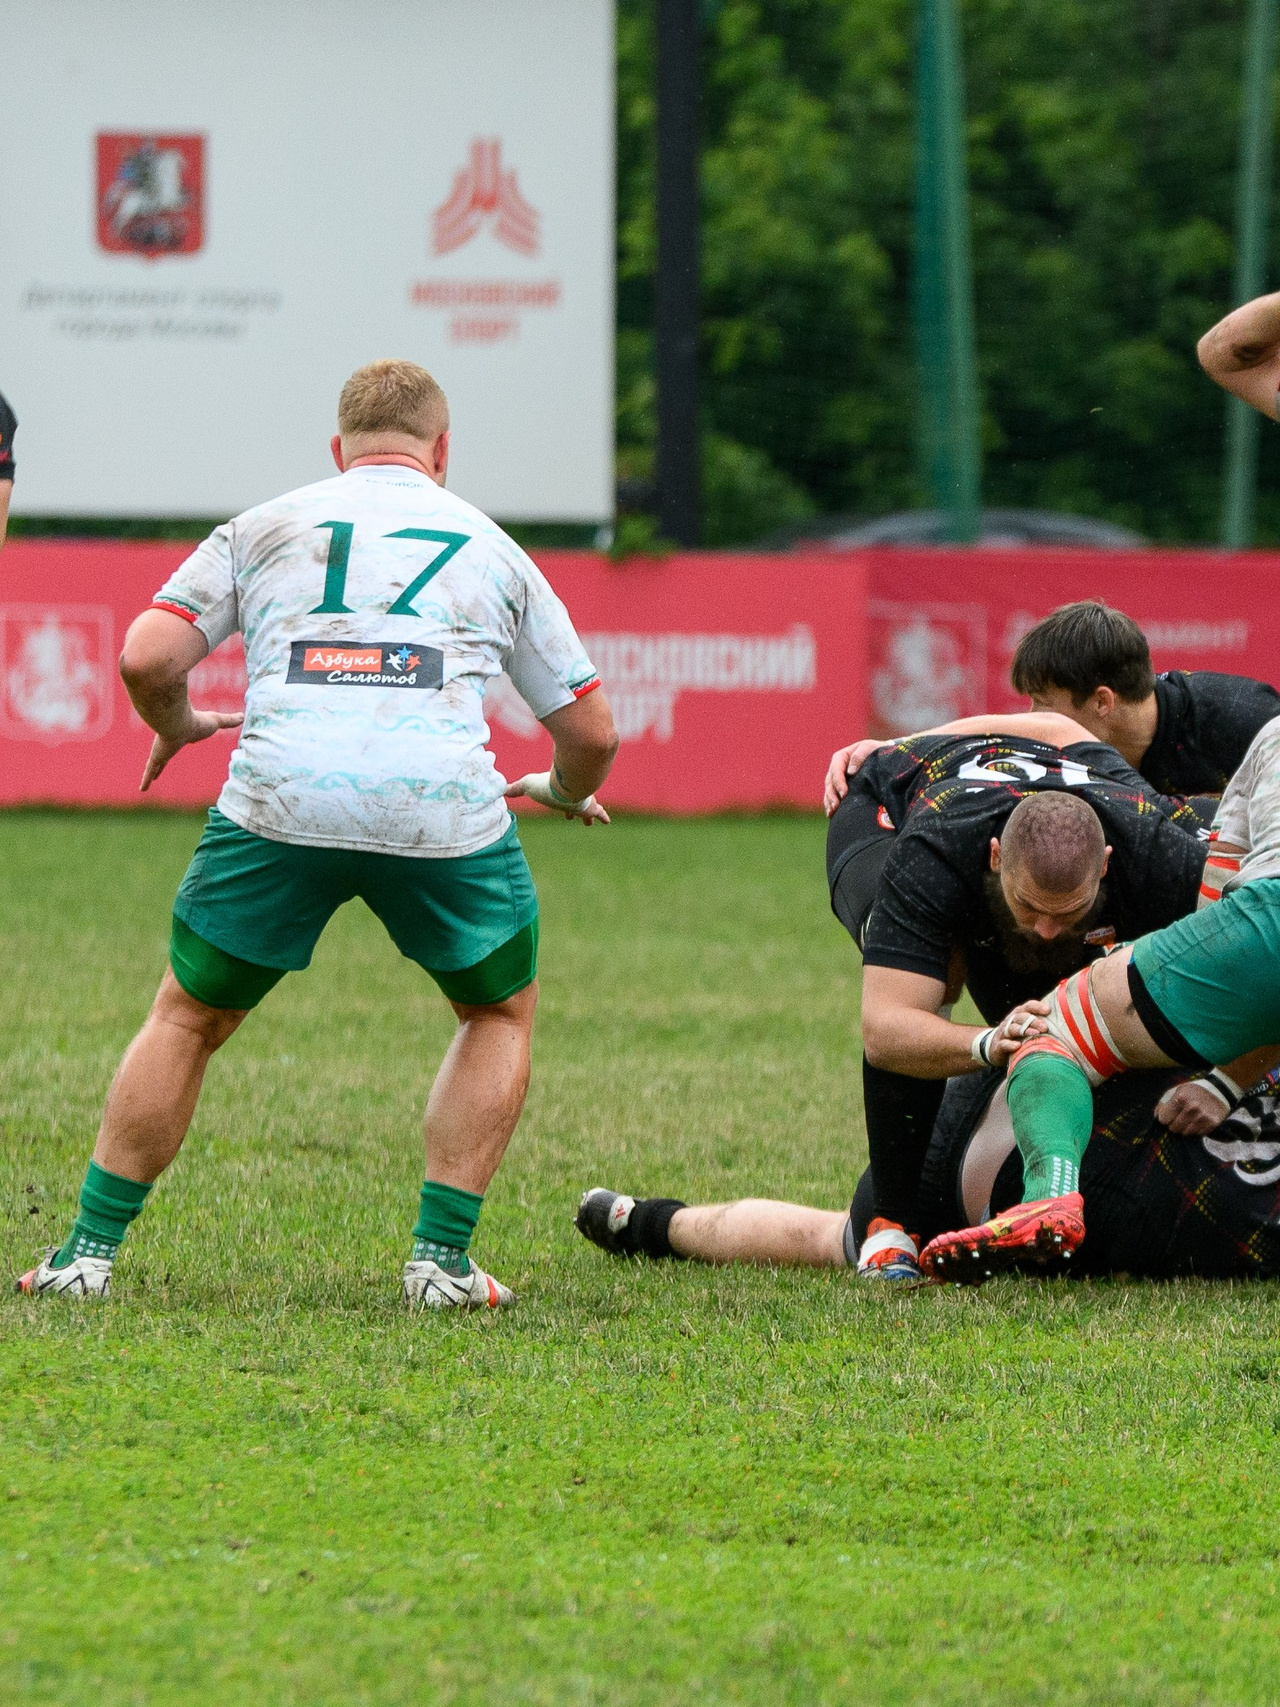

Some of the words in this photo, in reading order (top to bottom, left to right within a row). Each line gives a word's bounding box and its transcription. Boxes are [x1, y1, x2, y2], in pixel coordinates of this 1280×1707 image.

[307, 520, 472, 618] 17
[309, 652, 379, 668] Азбука
[326, 670, 417, 685] Салютов
[578, 622, 815, 691] ОСКОВСКИЙ
